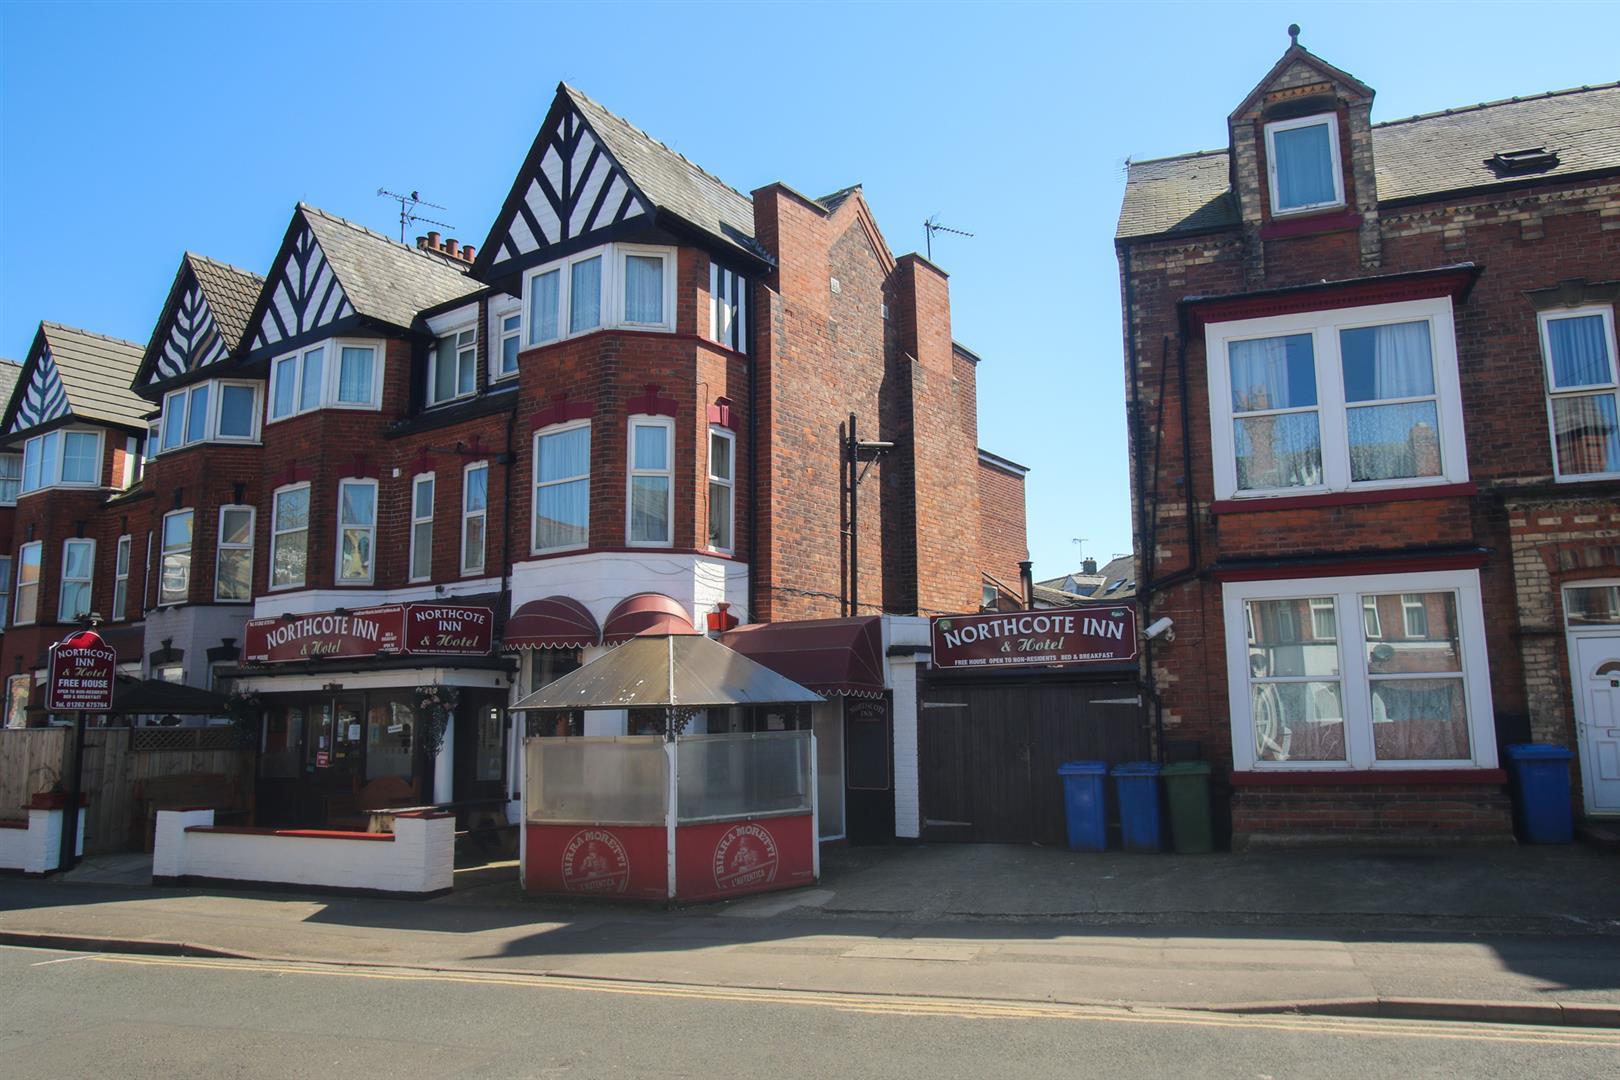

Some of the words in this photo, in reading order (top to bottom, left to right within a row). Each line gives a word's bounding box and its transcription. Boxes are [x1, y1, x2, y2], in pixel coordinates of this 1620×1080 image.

[416, 609, 485, 624] NORTHCOTE
[438, 620, 462, 631] INN
[944, 616, 1075, 649] NORTHCOTE
[1082, 617, 1124, 640] INN
[266, 616, 349, 650] NORTHCOTE
[352, 617, 379, 641] INN
[300, 644, 307, 655] &
[311, 639, 342, 655] Hotel
[420, 635, 430, 646] &
[436, 634, 479, 647] Hotel
[1000, 640, 1012, 653] &
[1017, 636, 1064, 652] Hotel
[58, 648, 113, 661] NORTHCOTE
[1013, 655, 1056, 663] NON-RESIDENTS
[1079, 652, 1114, 660] BREAKFAST
[75, 658, 95, 667] INN
[62, 667, 70, 676] &
[74, 667, 107, 677] Hotel
[58, 678, 79, 687] FREE
[81, 679, 108, 688] HOUSE
[564, 837, 585, 876] BIRRA
[585, 831, 627, 868] MORETTI
[716, 833, 736, 876] BIRRA
[736, 825, 776, 858] MORETTI
